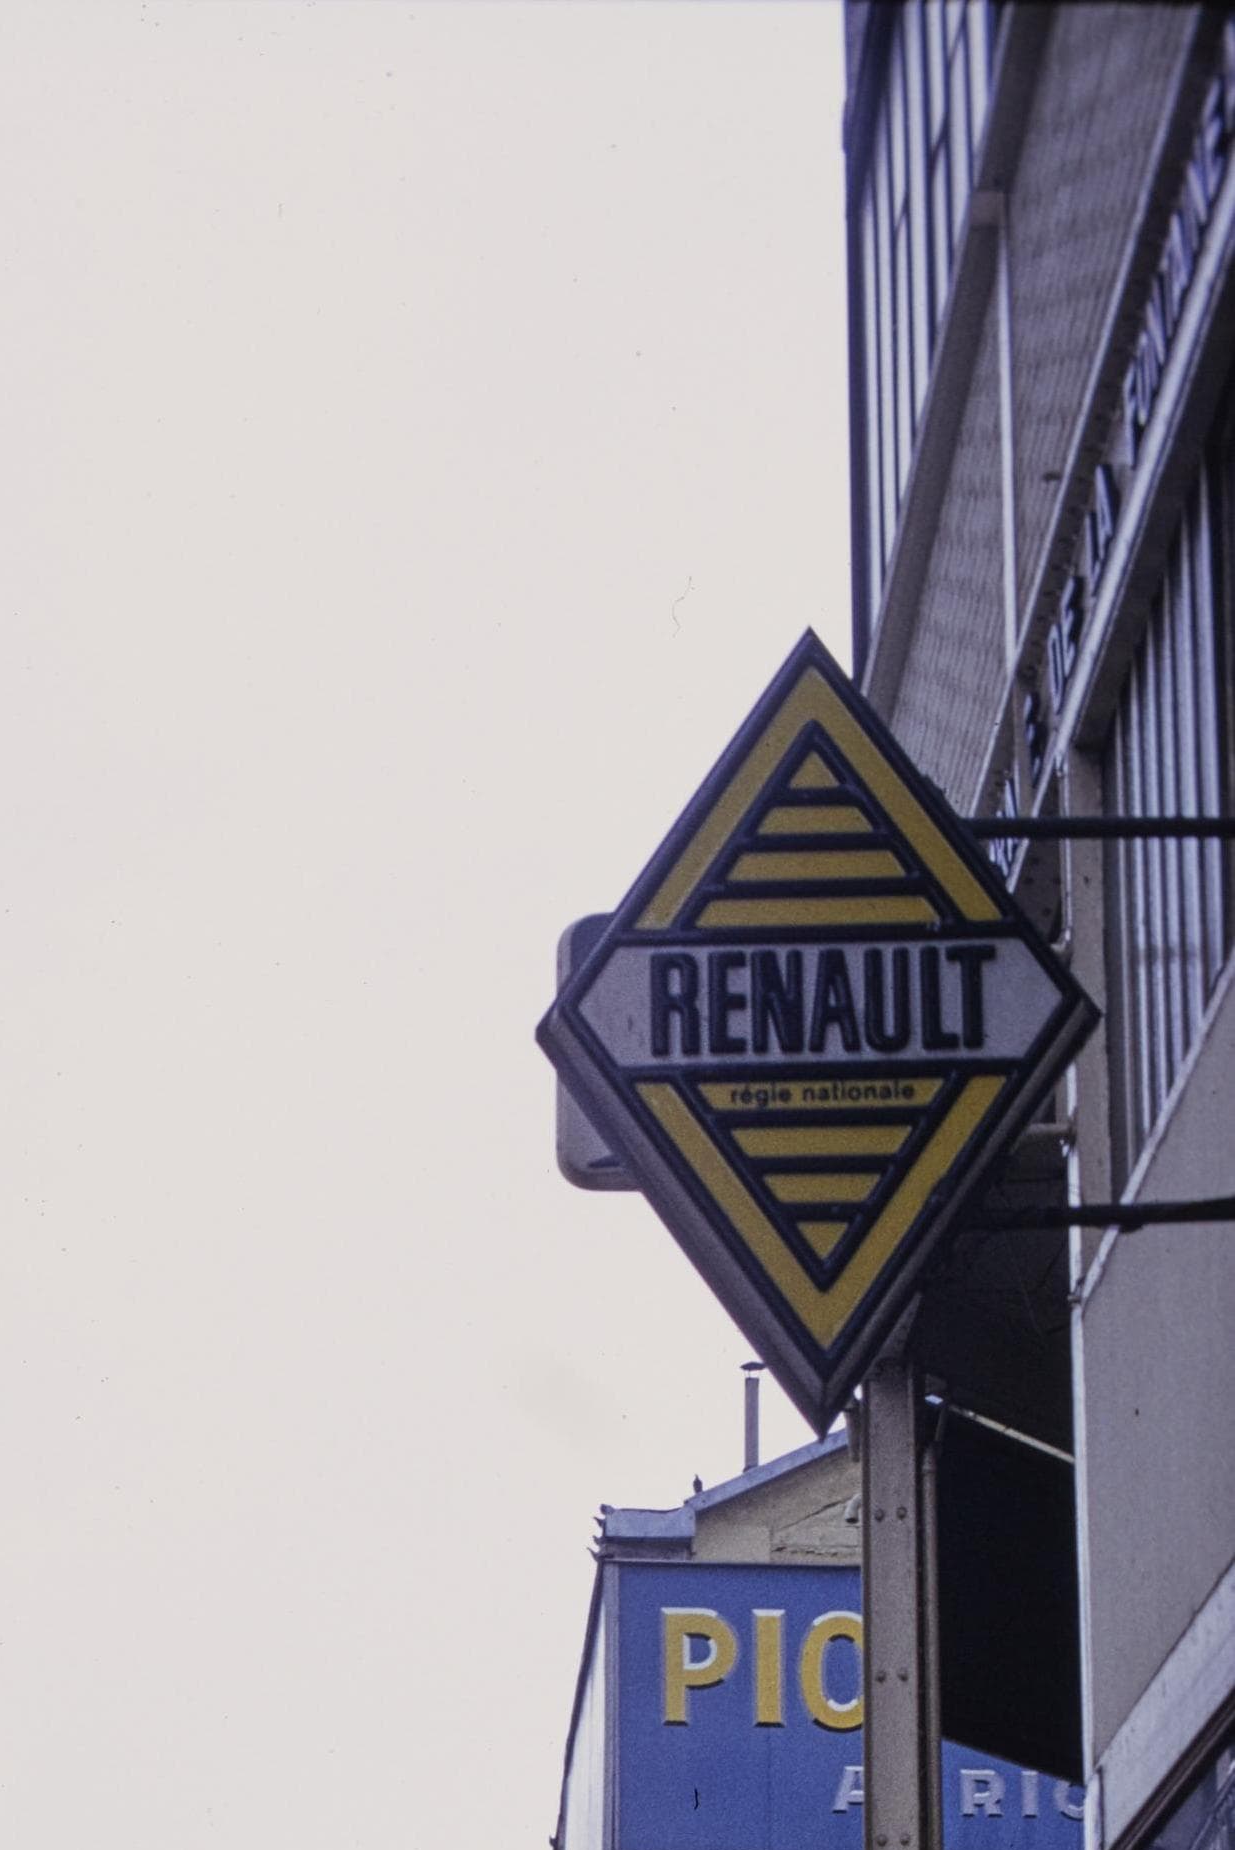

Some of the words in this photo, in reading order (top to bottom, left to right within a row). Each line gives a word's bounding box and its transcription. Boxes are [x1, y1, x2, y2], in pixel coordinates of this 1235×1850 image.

[650, 945, 996, 1058] RENAULT
[730, 1080, 792, 1106] régie
[802, 1077, 915, 1103] nationale
